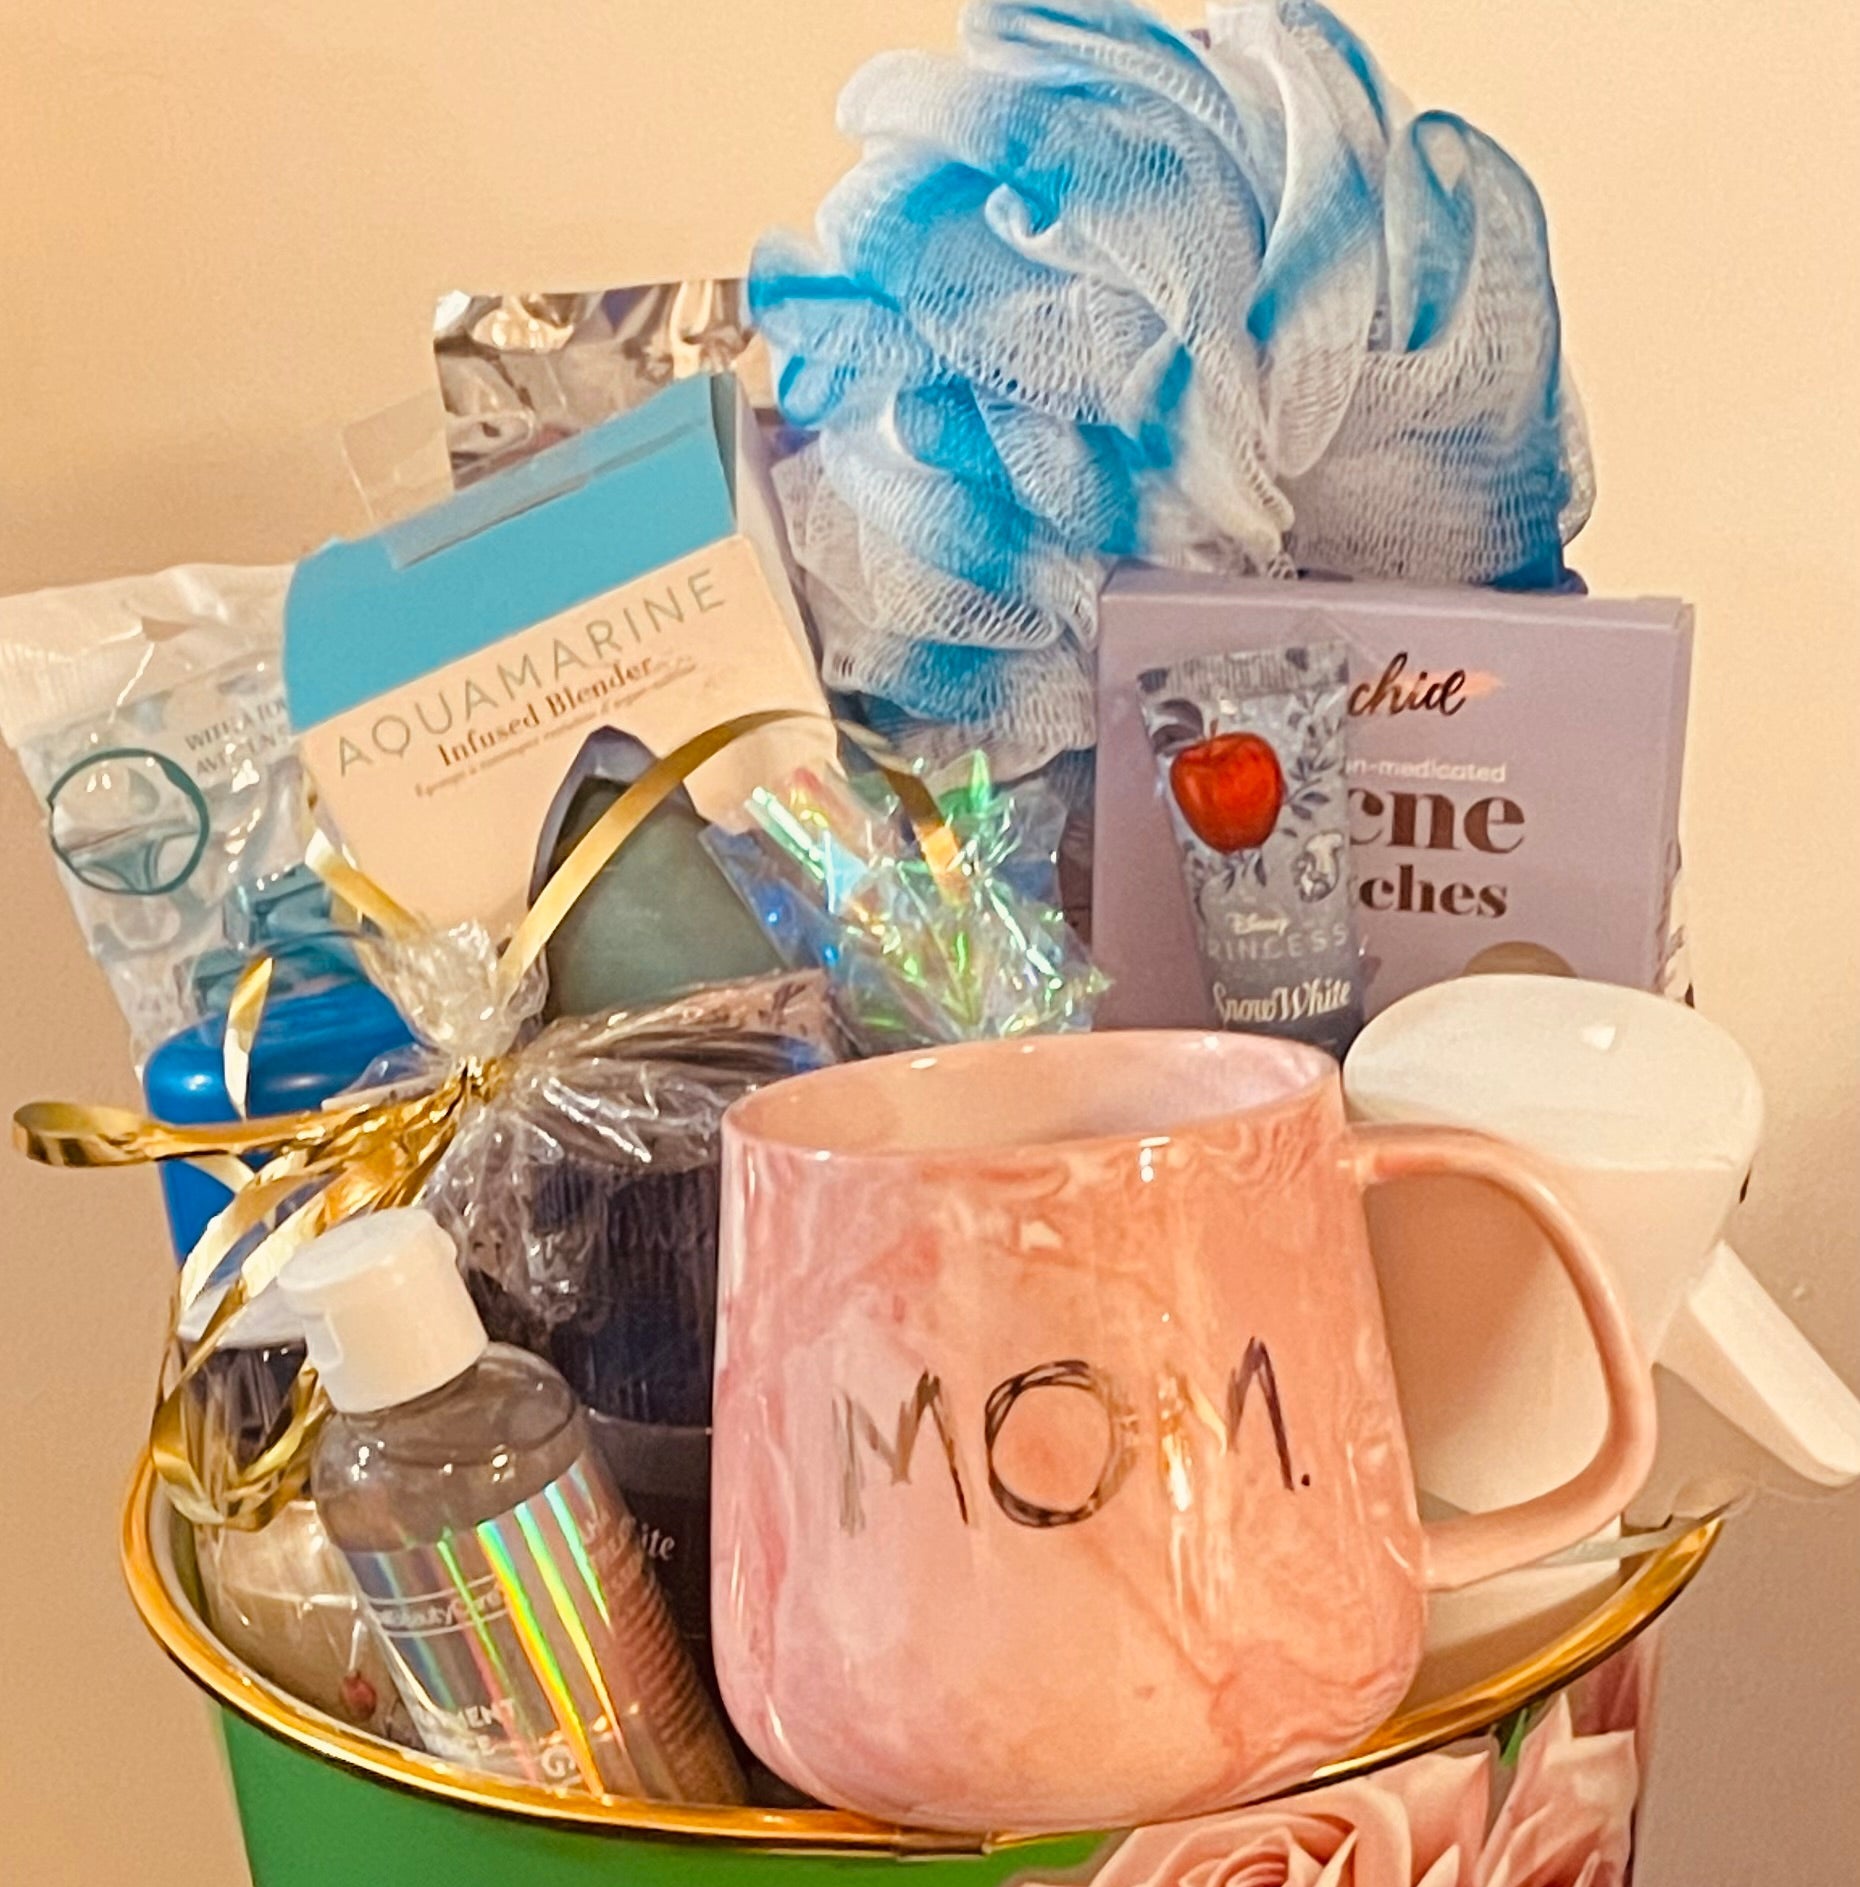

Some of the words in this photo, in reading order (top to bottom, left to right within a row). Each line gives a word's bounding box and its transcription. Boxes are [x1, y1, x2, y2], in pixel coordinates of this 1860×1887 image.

[336, 568, 727, 779] AQUAMARINE
[1347, 652, 1466, 716] chid
[437, 703, 540, 767] Infused
[545, 657, 652, 718] Blender
[1348, 758, 1506, 783] n-medicated
[1348, 788, 1525, 854] cne
[1359, 864, 1508, 919] ches
[1207, 922, 1348, 960] RINCESS
